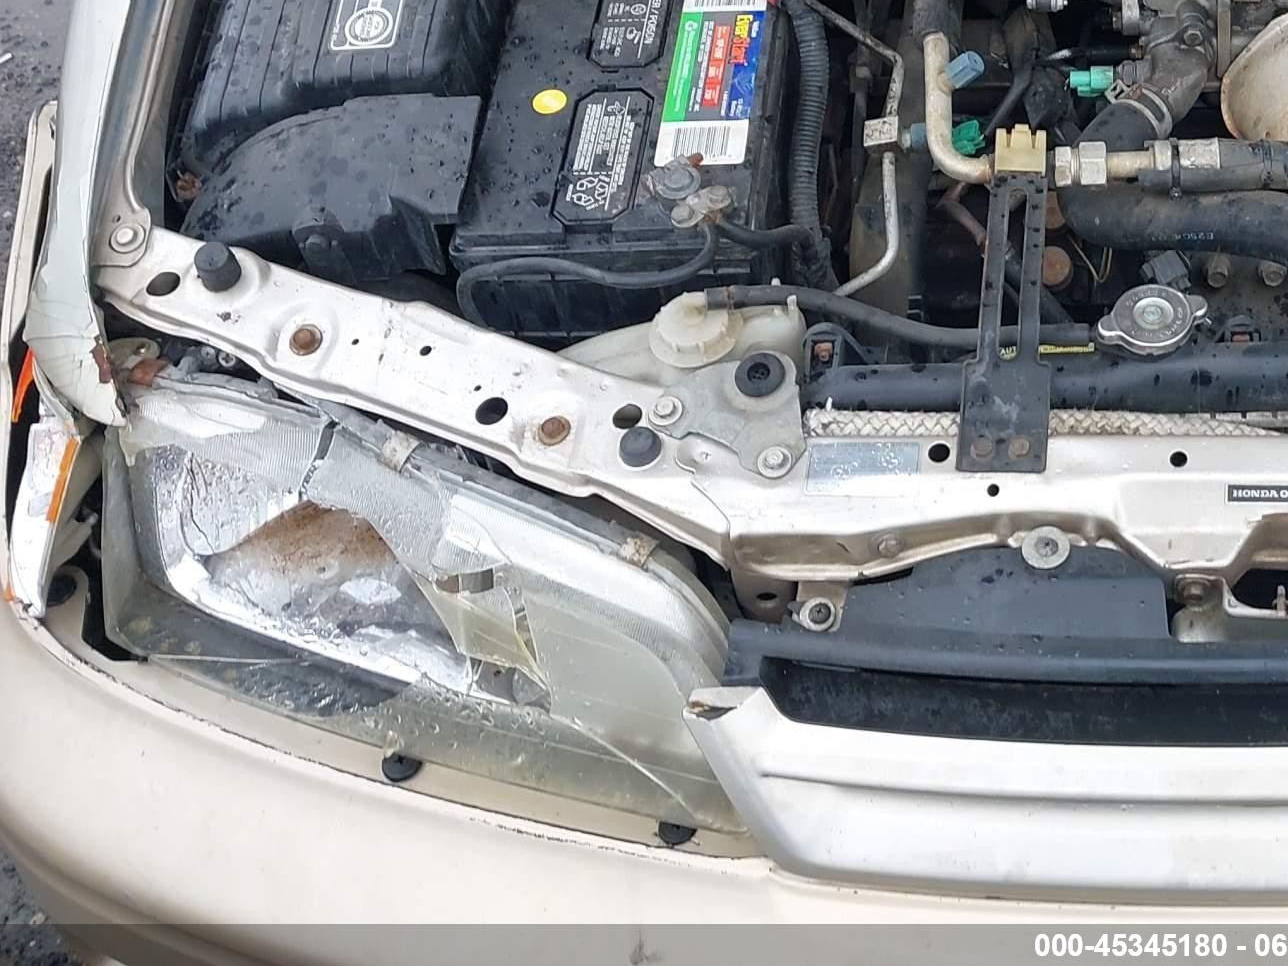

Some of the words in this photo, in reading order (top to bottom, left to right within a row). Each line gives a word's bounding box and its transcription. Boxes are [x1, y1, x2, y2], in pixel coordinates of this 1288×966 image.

[644, 14, 658, 44] POISON
[729, 14, 754, 65] EverStart
[1232, 488, 1278, 498] HONDA
